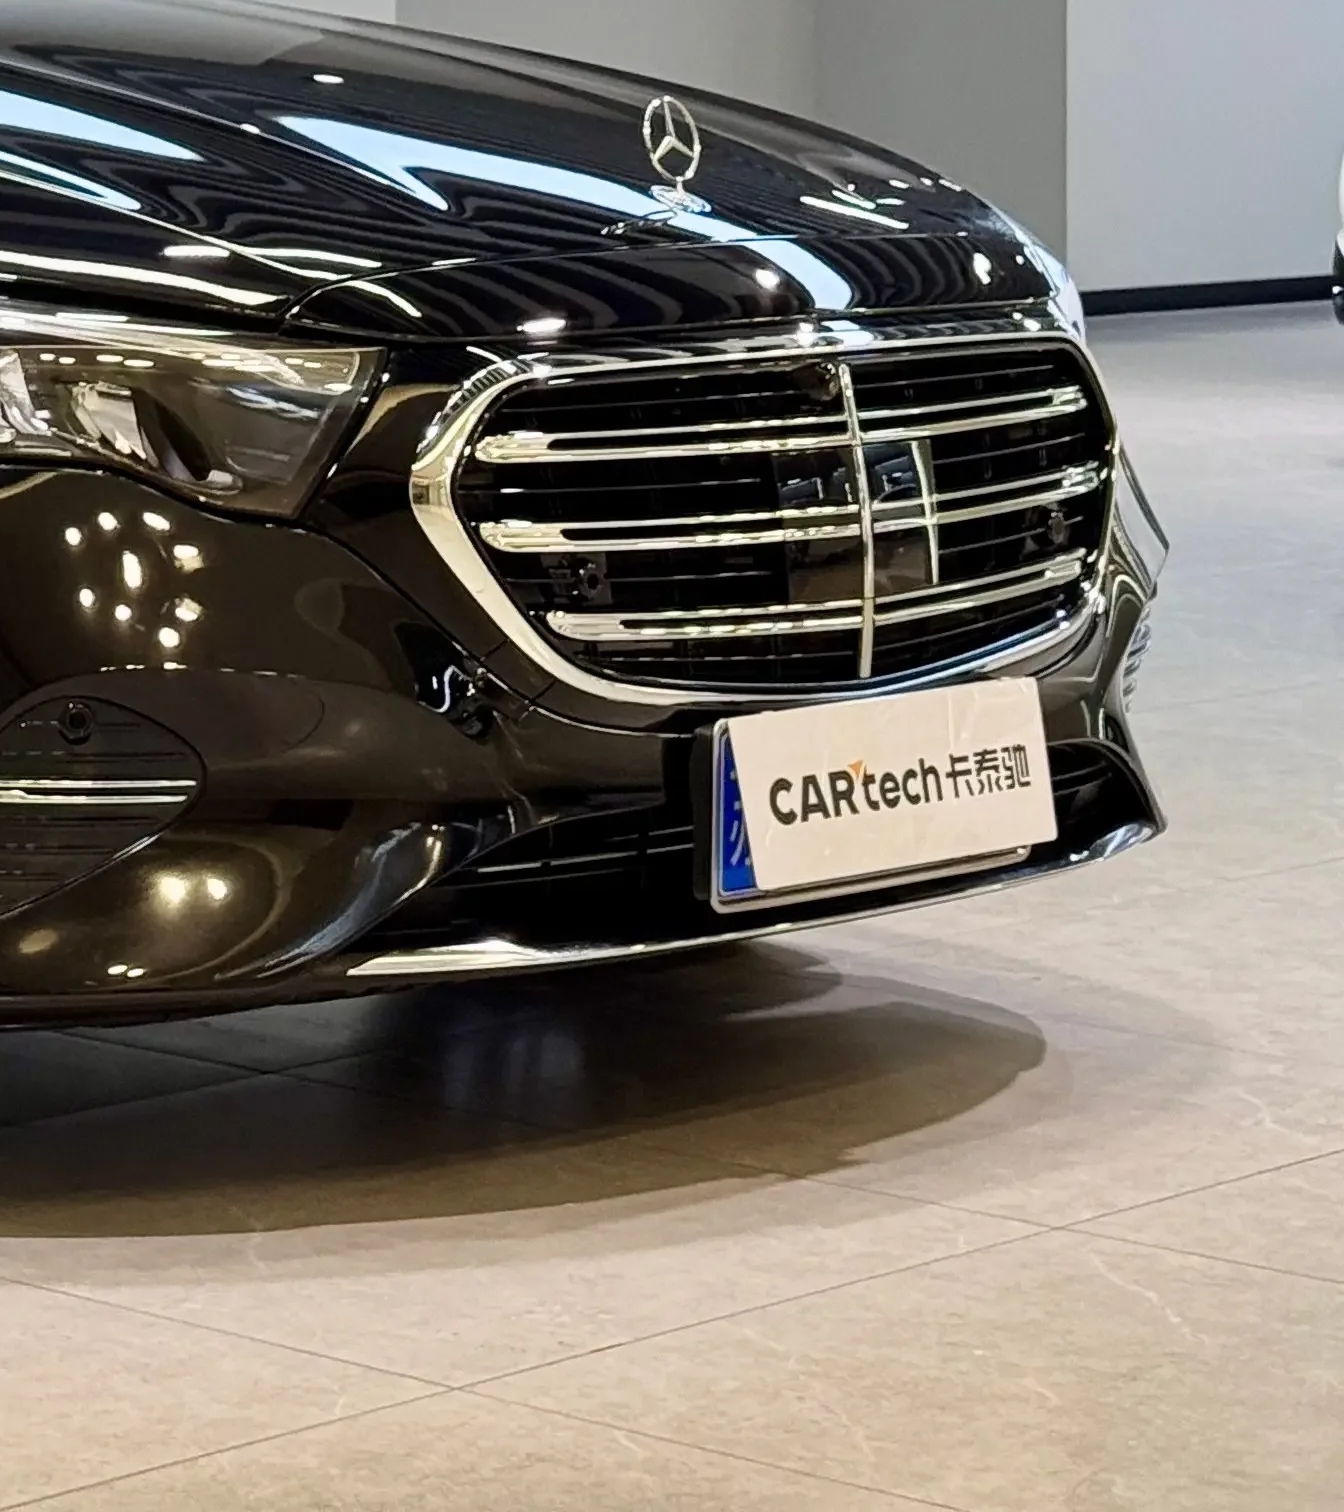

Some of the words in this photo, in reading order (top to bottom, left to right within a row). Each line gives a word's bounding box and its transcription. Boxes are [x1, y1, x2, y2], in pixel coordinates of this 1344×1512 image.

[769, 757, 944, 825] CARtech
[946, 743, 1031, 800] 卡泰驰
